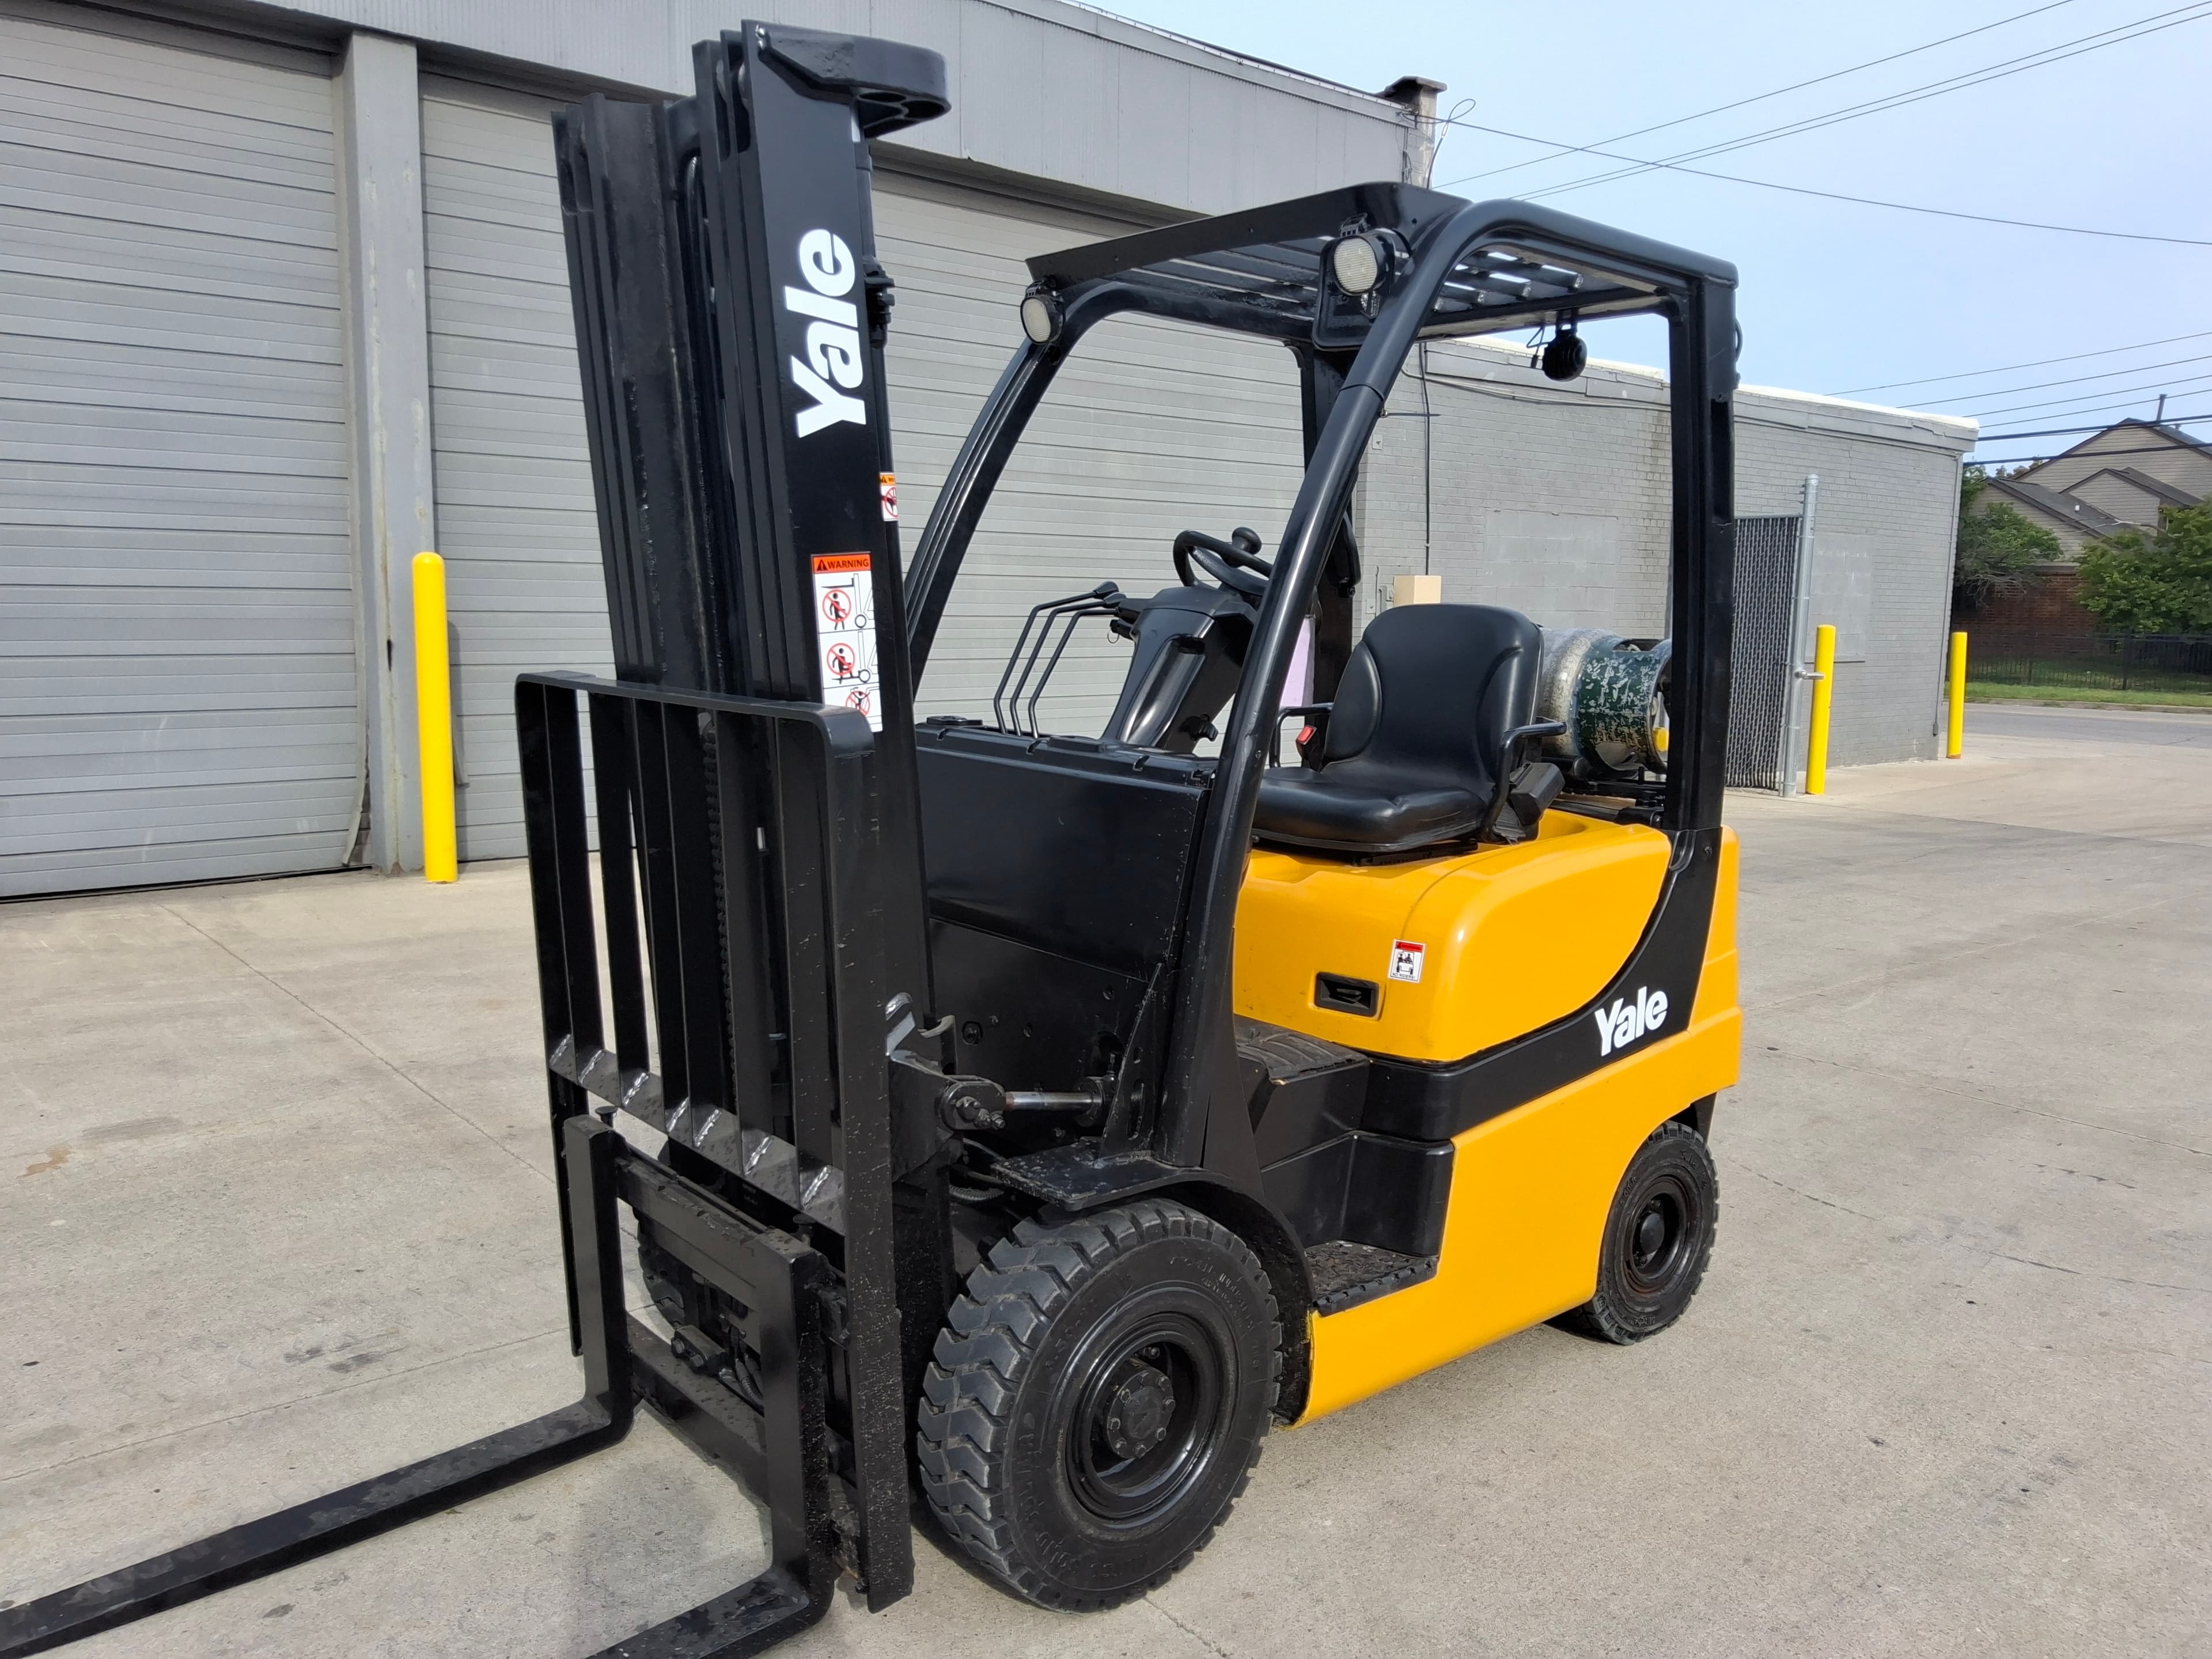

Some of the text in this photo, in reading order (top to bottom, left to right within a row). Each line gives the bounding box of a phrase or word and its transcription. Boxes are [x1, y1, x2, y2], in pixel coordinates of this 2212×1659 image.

[785, 229, 866, 438] Yale
[827, 559, 869, 570] WARNING
[1594, 986, 1668, 1056] Yale
